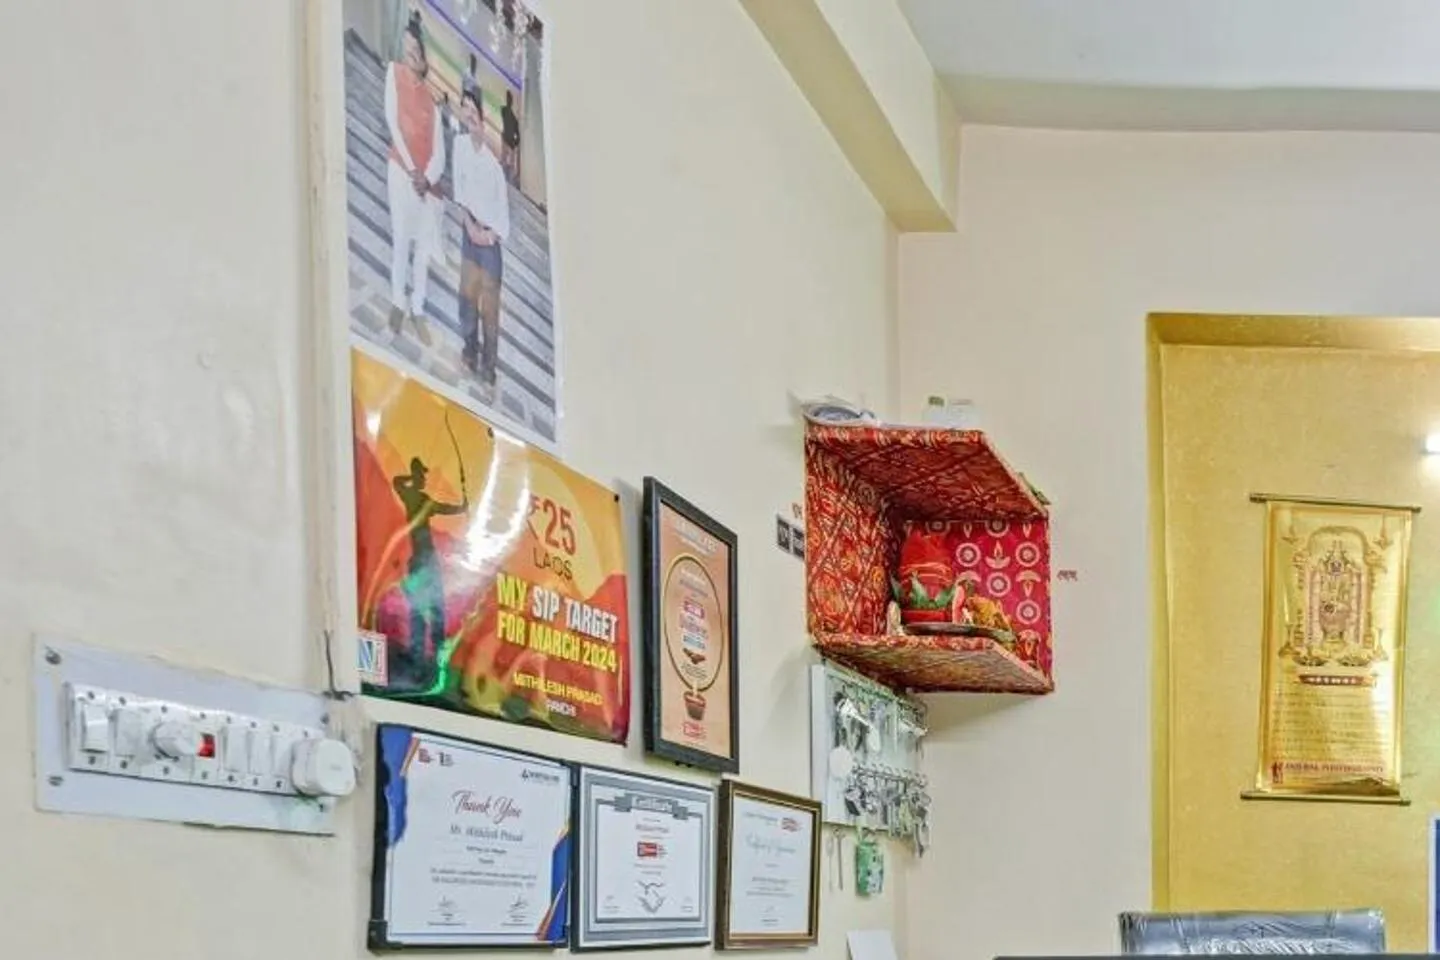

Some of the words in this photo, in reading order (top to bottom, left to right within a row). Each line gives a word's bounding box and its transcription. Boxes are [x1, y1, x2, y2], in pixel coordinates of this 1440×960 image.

[496, 573, 527, 611] MY
[532, 585, 560, 622] SIP
[564, 597, 618, 644] TARGET
[496, 610, 525, 646] FOR
[529, 621, 580, 662] MARCH
[582, 640, 618, 673] 2024
